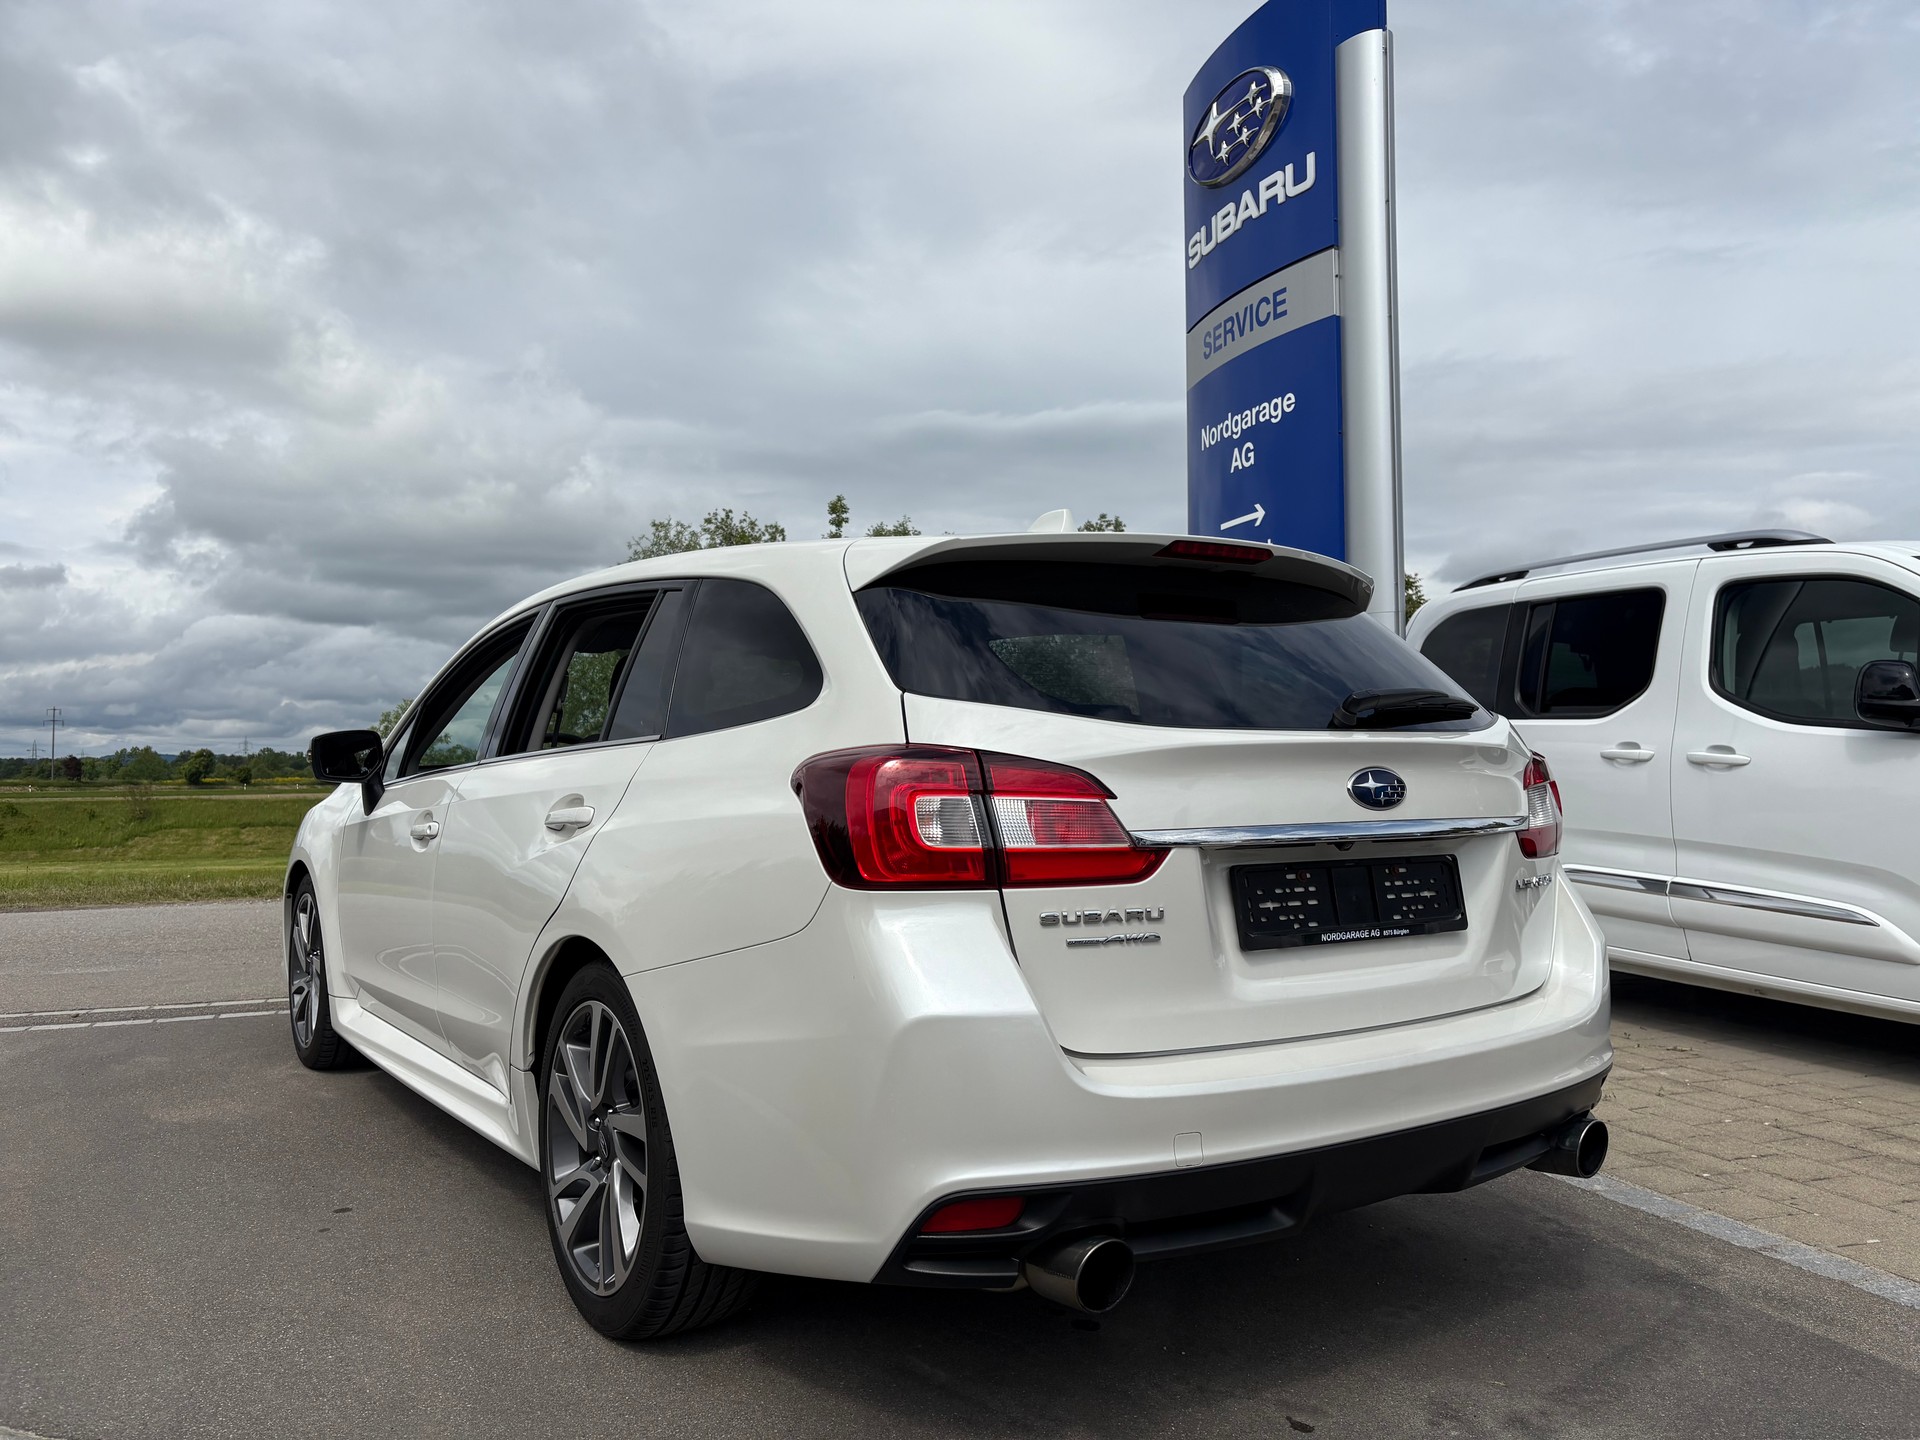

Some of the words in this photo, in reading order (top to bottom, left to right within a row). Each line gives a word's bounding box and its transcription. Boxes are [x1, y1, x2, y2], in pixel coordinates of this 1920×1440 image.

[1188, 152, 1316, 270] SUBARU
[1203, 287, 1288, 360] SERVICE
[1201, 392, 1296, 451] Nordgarage
[1230, 441, 1255, 473] AG
[1040, 907, 1165, 927] SUBARU
[1321, 929, 1370, 942] NORDGARAGE
[1370, 928, 1380, 937] AG
